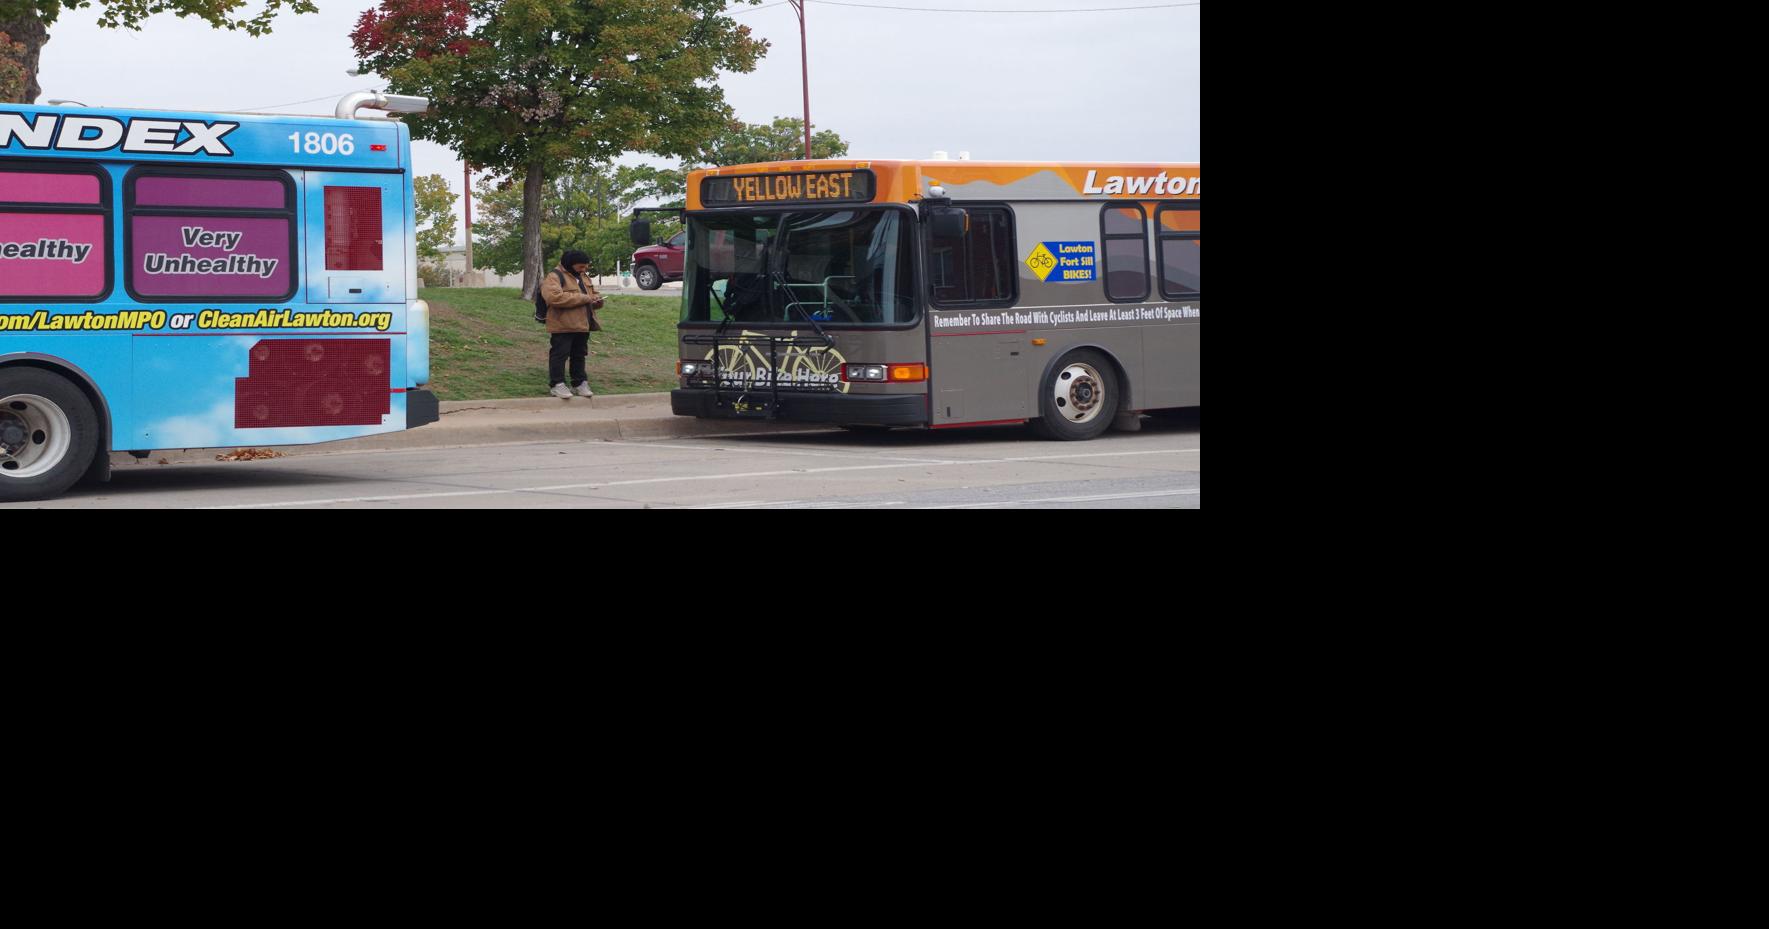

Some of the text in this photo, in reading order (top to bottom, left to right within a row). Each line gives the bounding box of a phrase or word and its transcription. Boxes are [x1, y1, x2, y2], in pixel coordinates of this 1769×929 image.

[0, 112, 240, 156] NDEX
[288, 131, 355, 156] 1806
[733, 172, 853, 201] YELLOW EAST
[1083, 169, 1200, 195] Lawton
[182, 227, 241, 249] Very
[1059, 244, 1093, 253] Lawton
[0, 239, 92, 263] ealthy
[1060, 256, 1093, 266] Fort Sill
[145, 254, 277, 278] Unhealthy
[1063, 270, 1092, 279] BIKES!
[170, 313, 192, 328] or
[198, 309, 391, 330] CleanAirLawton.org
[934, 305, 1200, 327] Remember To Share The Road With Cyclists And Leave At Least 3 Feet Of Space When
